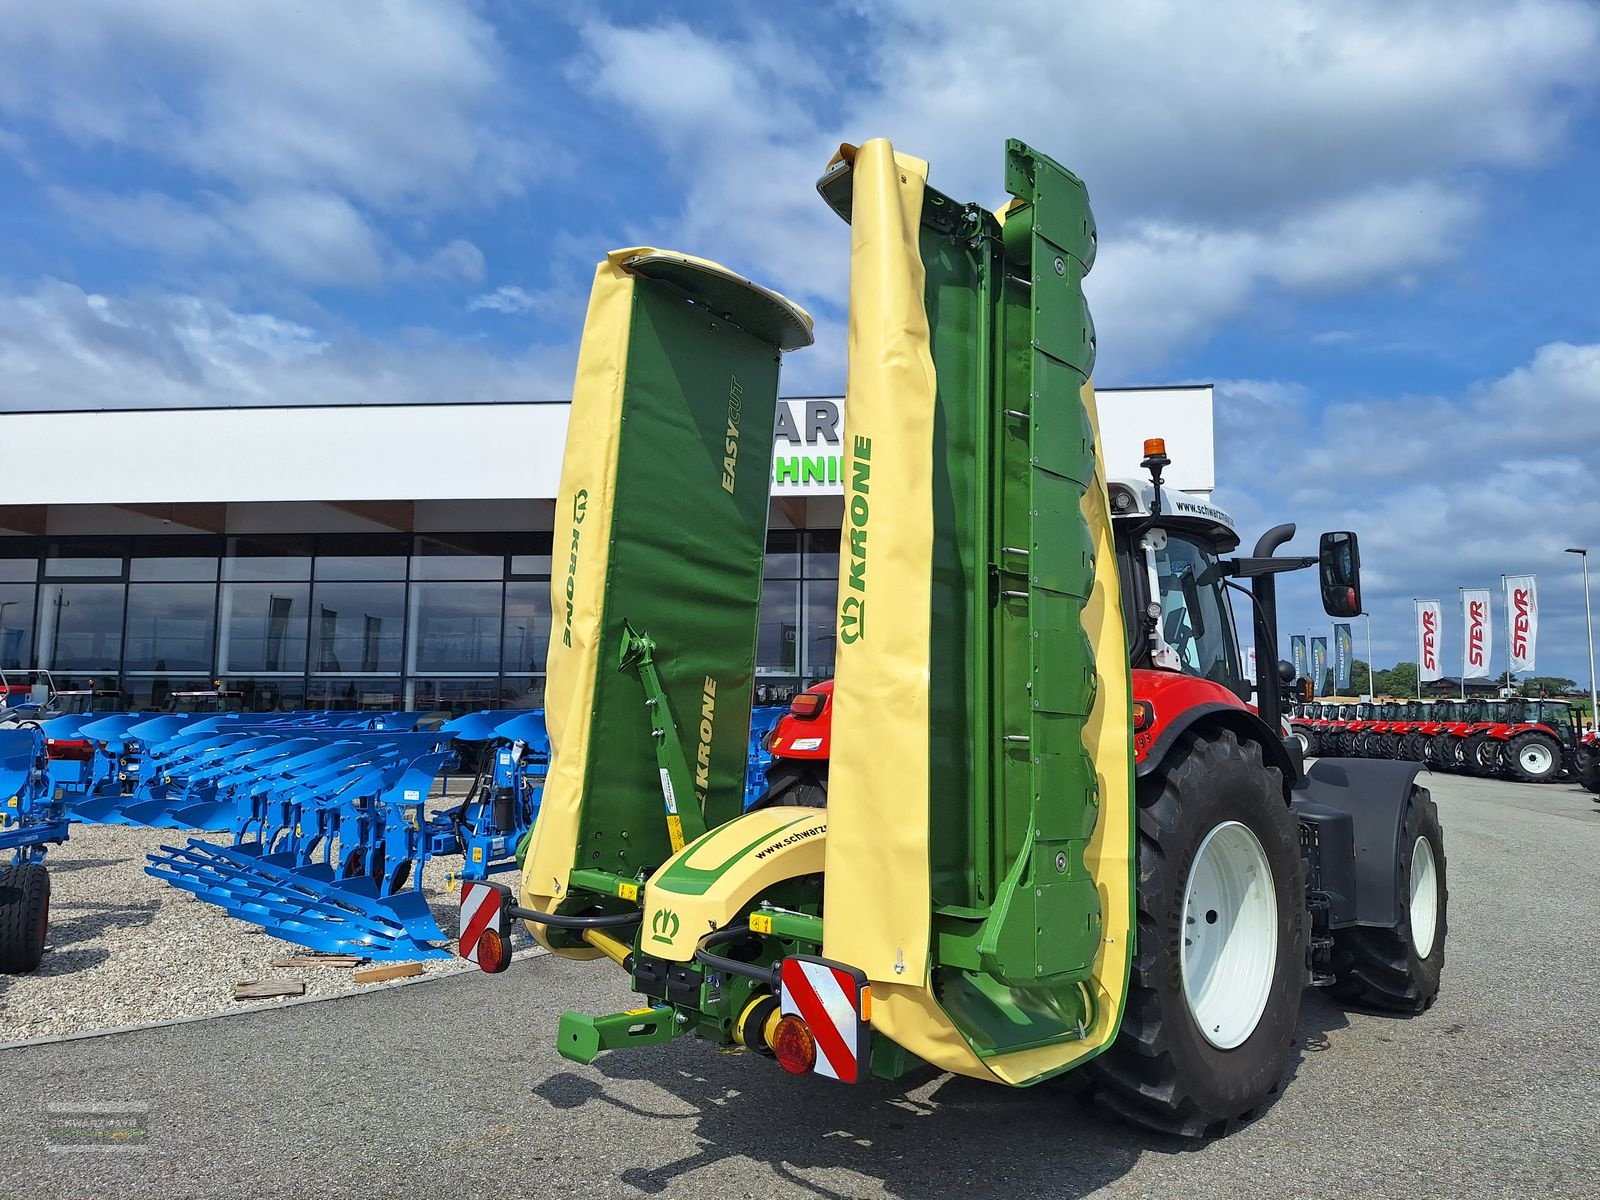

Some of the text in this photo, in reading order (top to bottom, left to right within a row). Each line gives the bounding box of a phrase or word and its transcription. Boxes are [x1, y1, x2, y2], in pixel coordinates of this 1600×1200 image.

[721, 374, 743, 494] EASYCUT
[772, 455, 844, 484] HNI
[849, 434, 872, 593] KRONE
[562, 528, 581, 649] KRONE
[1469, 600, 1483, 667] STEYR
[1513, 588, 1529, 660] STEYR
[1422, 610, 1436, 671] STEYR
[695, 675, 717, 790] KRONE
